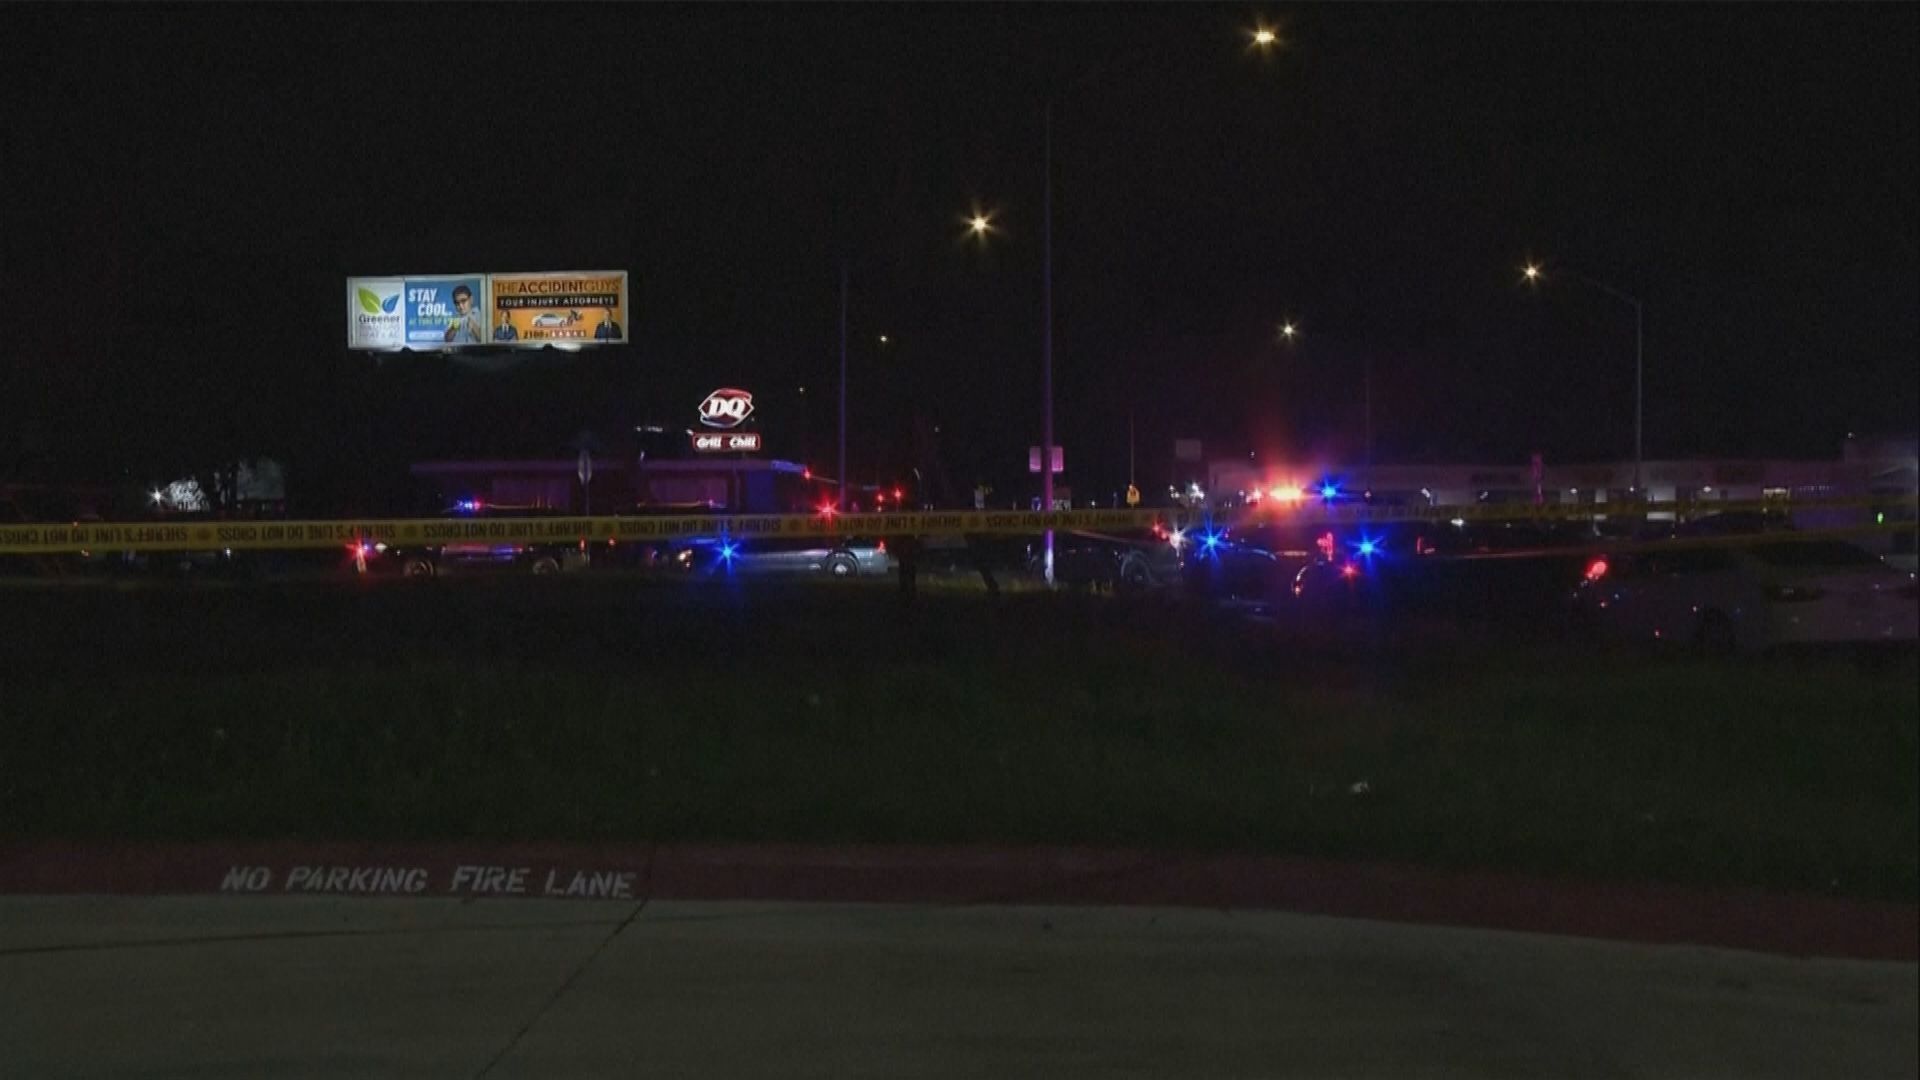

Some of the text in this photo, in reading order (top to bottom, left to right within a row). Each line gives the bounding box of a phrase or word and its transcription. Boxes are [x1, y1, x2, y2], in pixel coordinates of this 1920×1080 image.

[408, 288, 438, 302] STAY
[500, 296, 614, 306] YOUR INJURY ATTORNEYS
[418, 303, 452, 316] COOL.
[358, 314, 400, 324] Greener
[708, 397, 746, 418] DQ
[696, 436, 756, 448] Grill Chill
[72, 528, 89, 544] DO
[96, 527, 122, 544] LINE
[217, 527, 256, 542] CROSS
[261, 526, 284, 541] NOT
[287, 526, 303, 541] DO
[309, 526, 333, 540] LINE
[424, 524, 461, 539] CROSS
[465, 523, 486, 538] NOT
[490, 523, 505, 538] DO
[512, 522, 534, 537] LINE
[620, 522, 656, 535] CROSS
[44, 529, 67, 544] NOT
[221, 866, 637, 899] NO PARKING FIRE LANE
